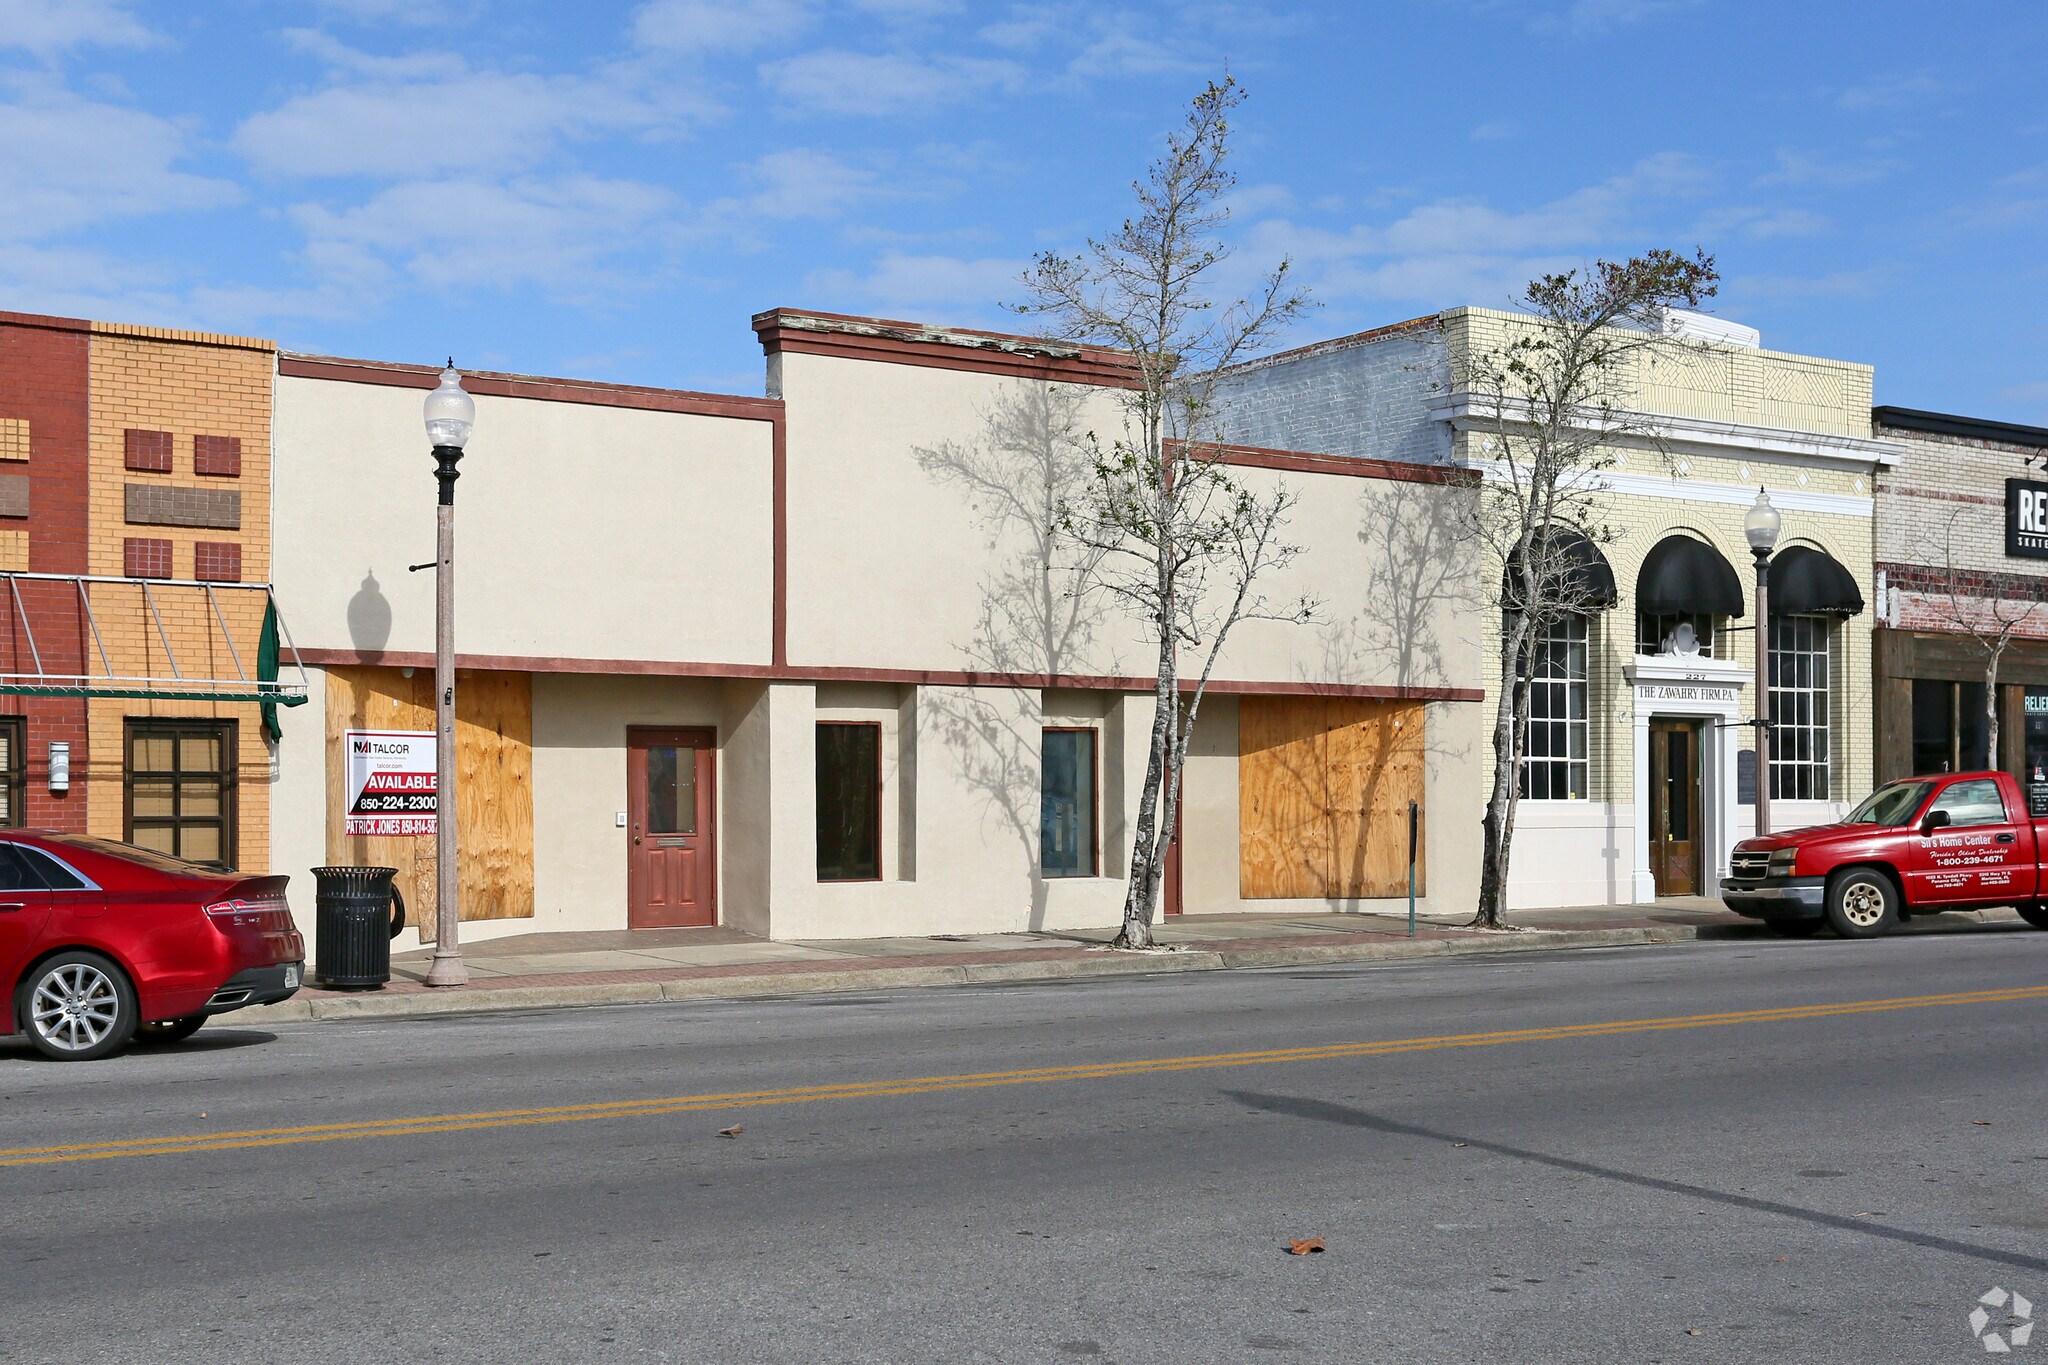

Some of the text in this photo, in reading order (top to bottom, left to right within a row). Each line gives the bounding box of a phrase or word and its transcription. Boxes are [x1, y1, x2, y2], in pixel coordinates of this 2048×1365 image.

[2018, 489, 2048, 533] RE
[1685, 673, 1706, 681] 227
[1639, 686, 1656, 698] THE
[1658, 687, 1698, 700] ZAWAHRY
[353, 740, 410, 754] NAI TALCOR
[368, 775, 437, 790] AVAILABLE
[360, 795, 437, 810] 850-224-2300
[346, 819, 376, 835] PATRICK
[376, 820, 400, 835] JONES
[1940, 837, 1963, 848] Home
[1965, 834, 1991, 846] Center
[1929, 847, 2008, 859] Florida's Oldest Dealership
[1936, 855, 2004, 866] 1-800-239-4671
